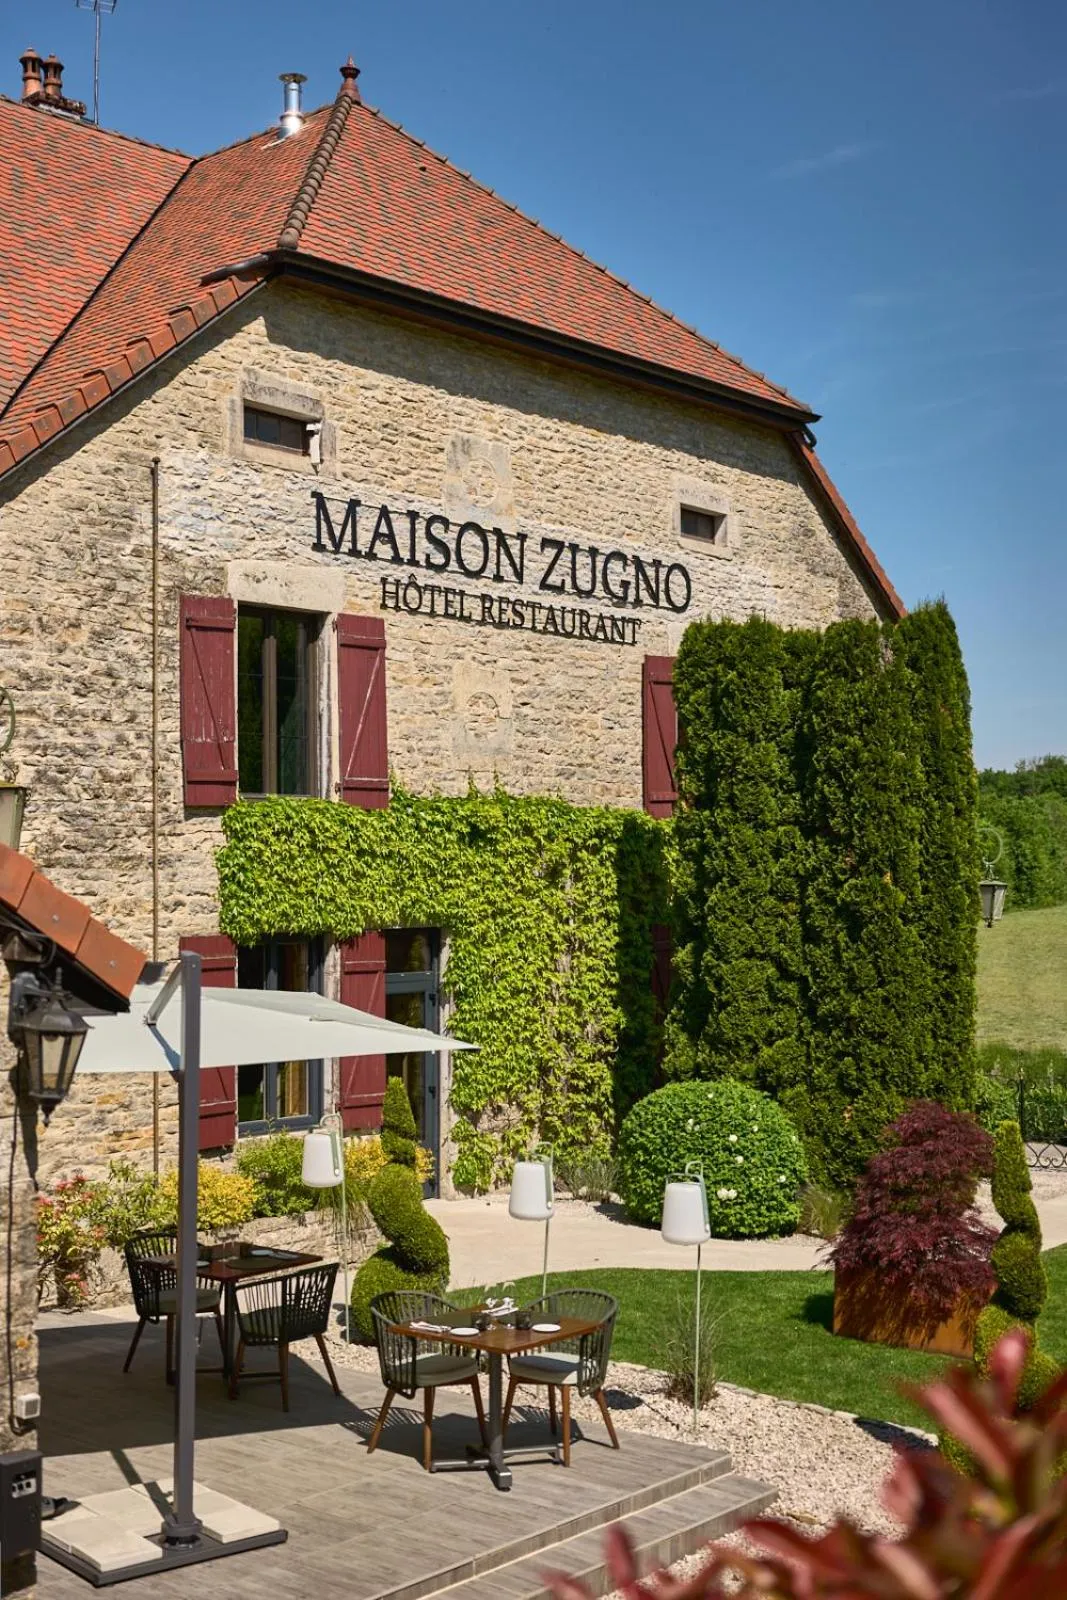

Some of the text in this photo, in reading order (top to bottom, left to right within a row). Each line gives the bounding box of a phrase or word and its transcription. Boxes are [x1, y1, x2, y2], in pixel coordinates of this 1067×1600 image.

[311, 491, 692, 613] MAISON ZUGNO
[380, 574, 641, 645] HÔTEL RESTAURANT
